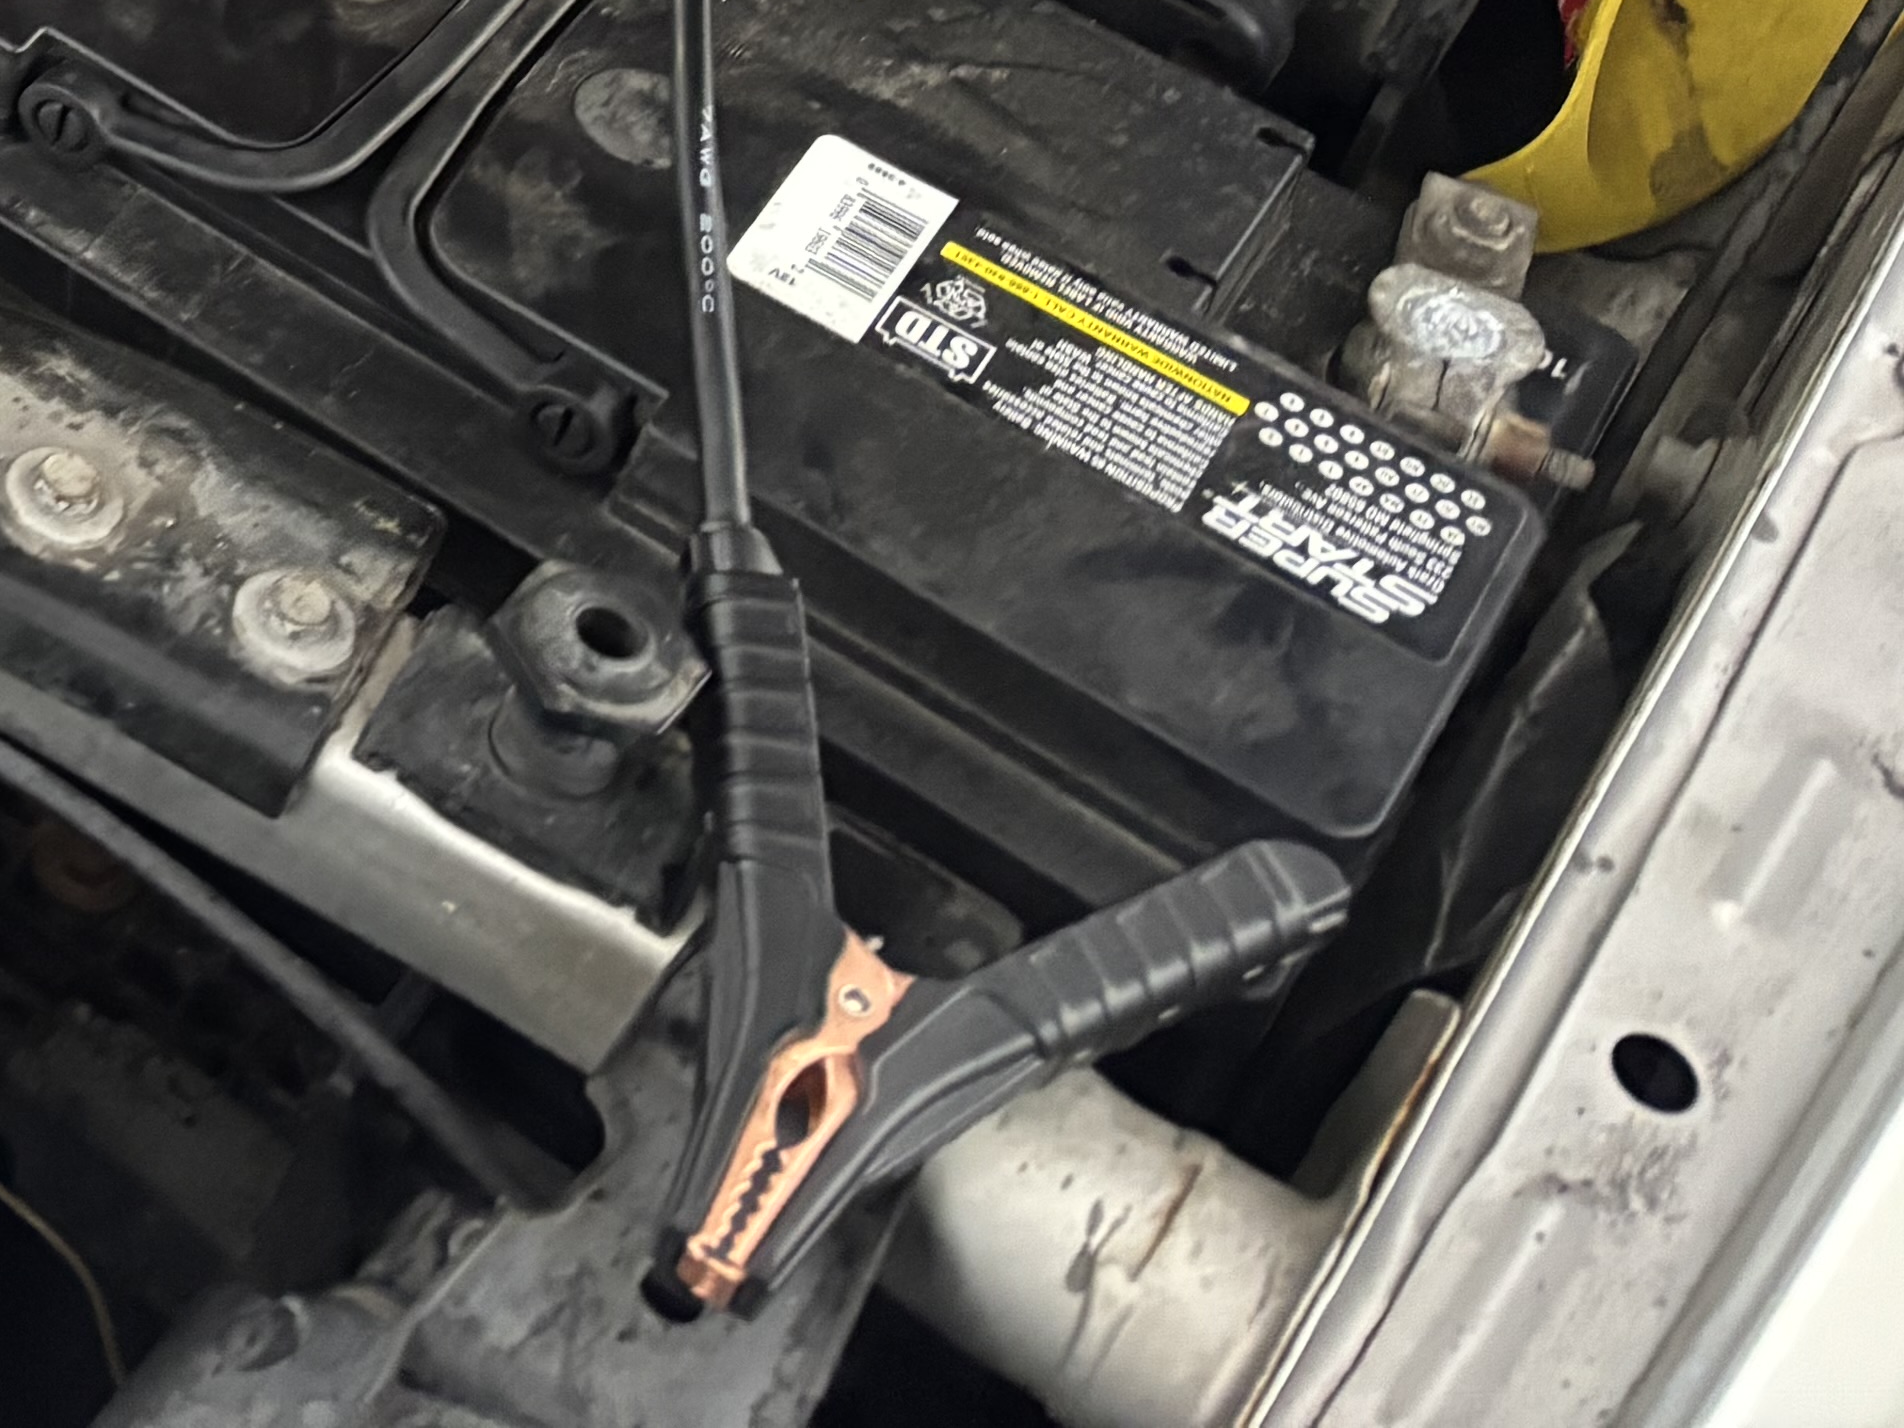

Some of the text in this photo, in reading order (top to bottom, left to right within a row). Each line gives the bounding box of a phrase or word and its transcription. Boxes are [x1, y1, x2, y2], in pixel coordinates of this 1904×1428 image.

[1045, 298, 1075, 318] CALL
[895, 310, 977, 368] STD
[1078, 317, 1148, 358] WARRANTY
[1154, 357, 1231, 402] NATIONWIDE
[1203, 505, 1393, 621] SUPER
[1214, 487, 1435, 614] START
